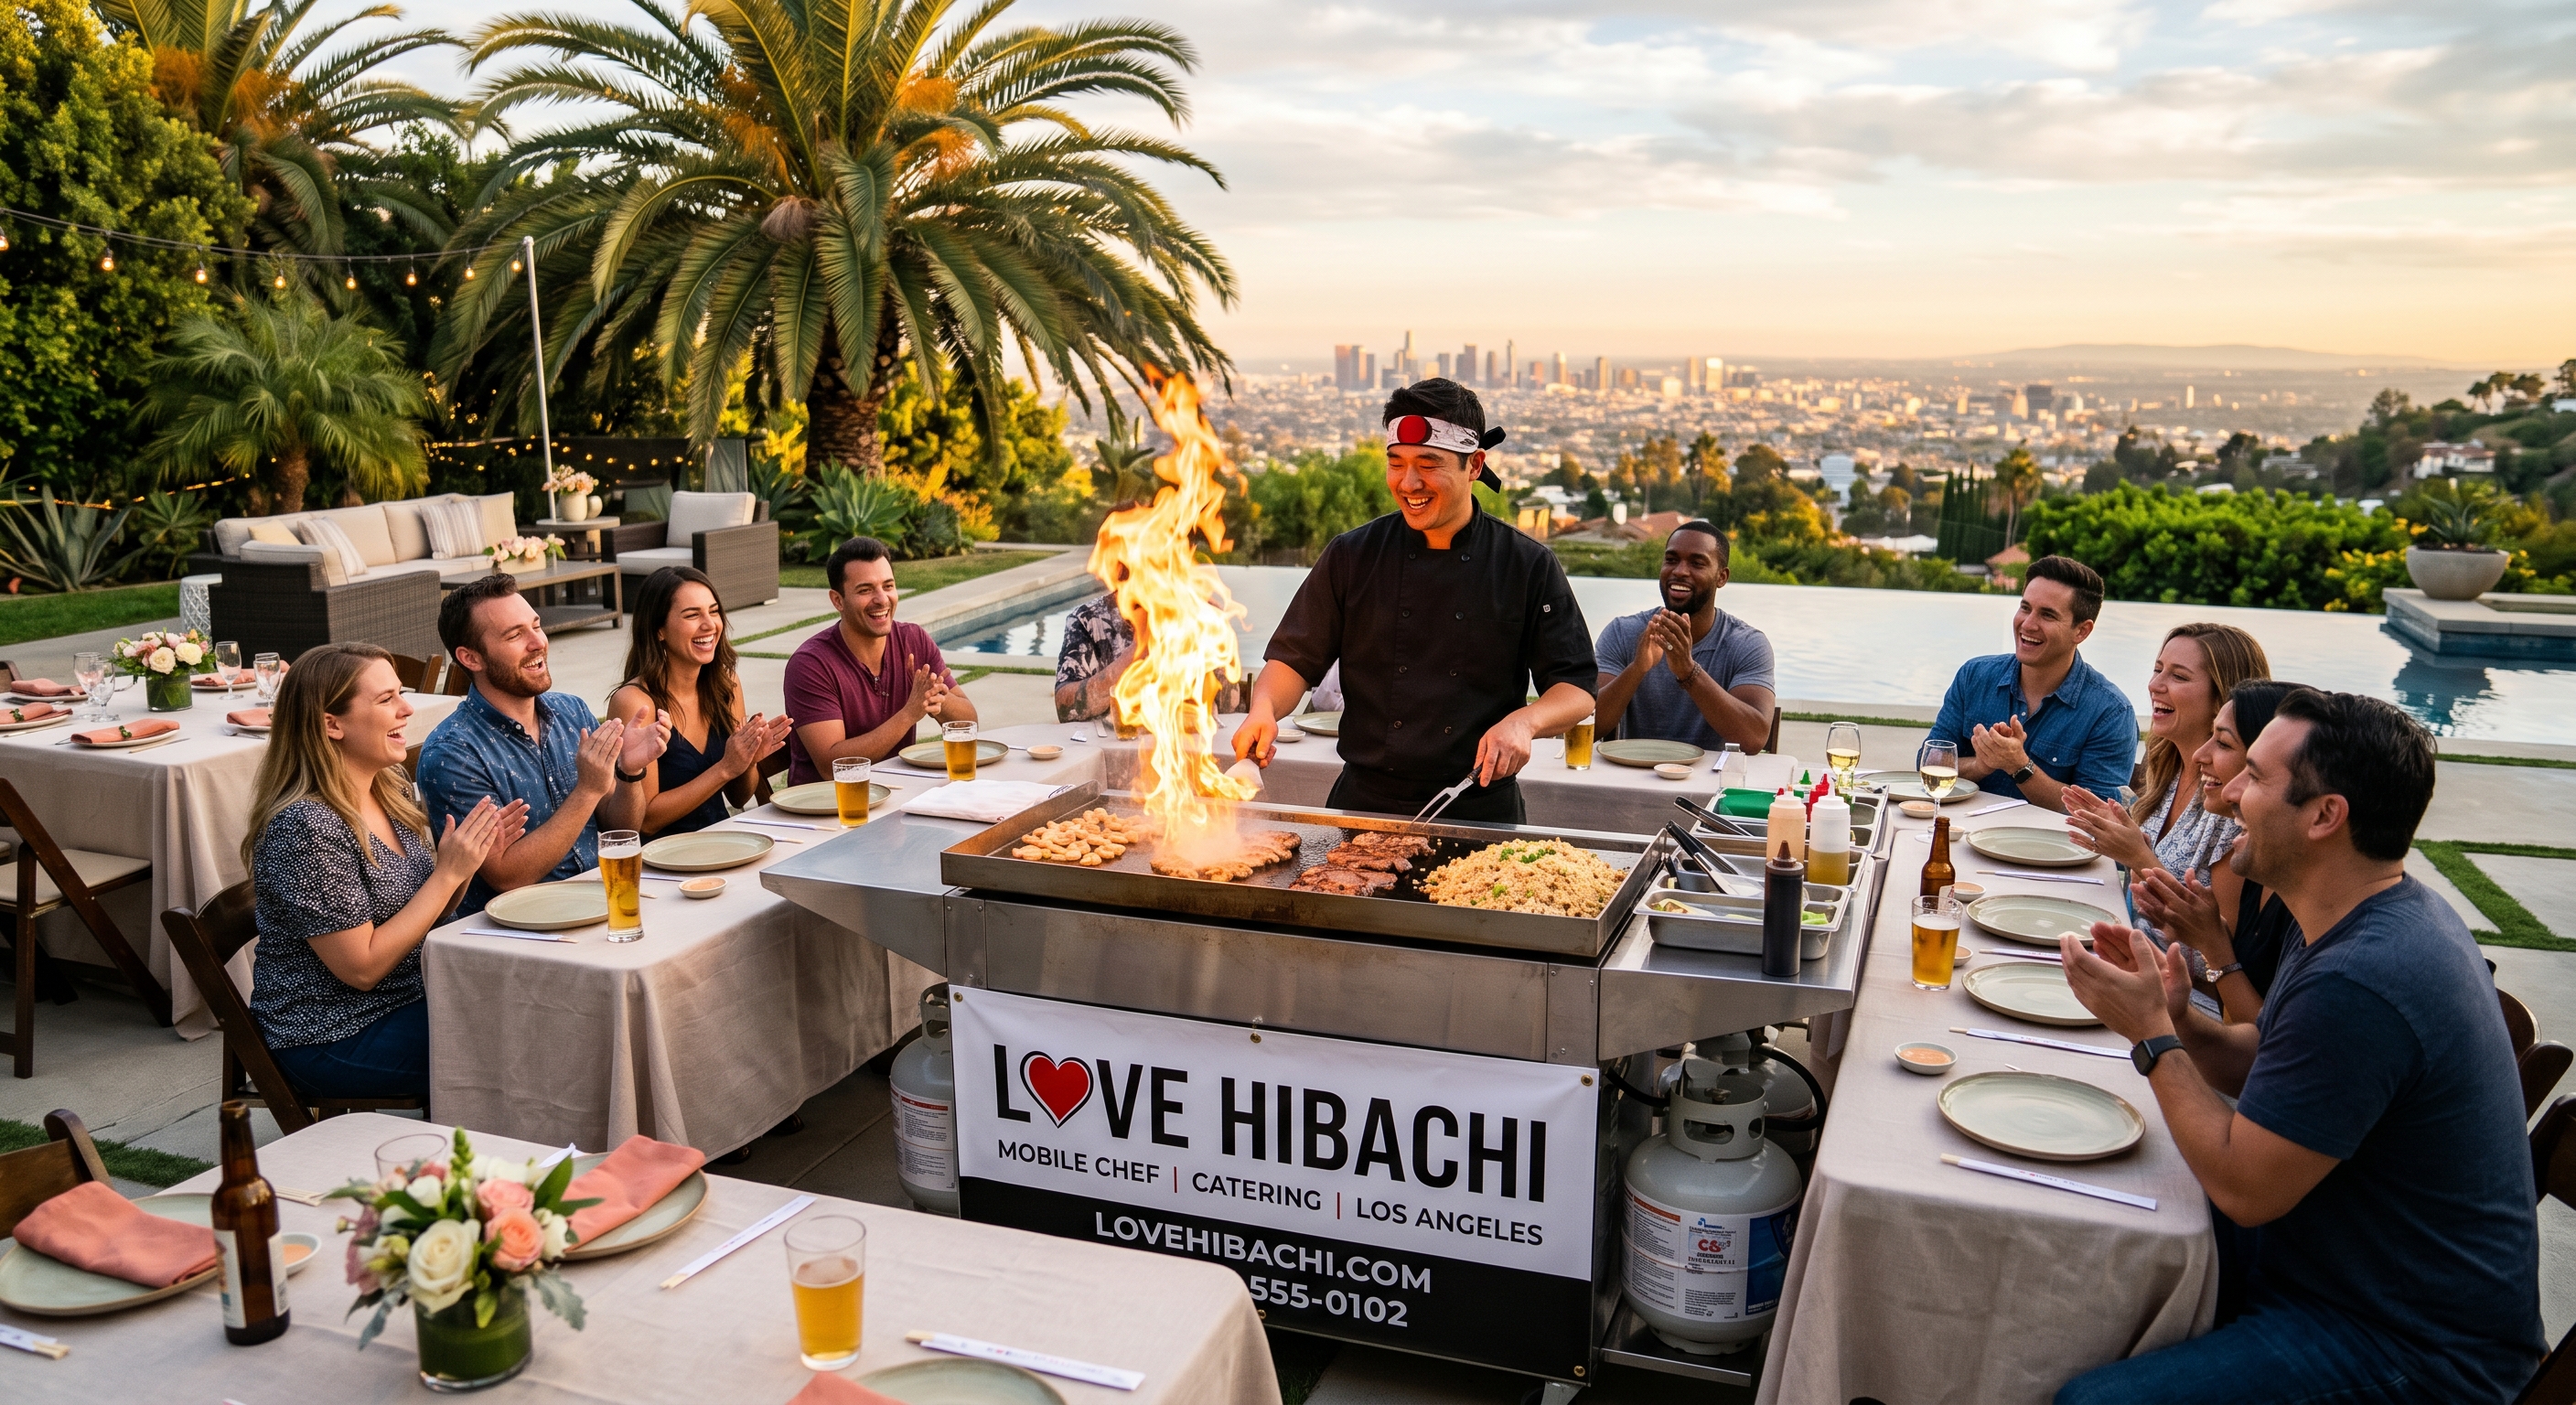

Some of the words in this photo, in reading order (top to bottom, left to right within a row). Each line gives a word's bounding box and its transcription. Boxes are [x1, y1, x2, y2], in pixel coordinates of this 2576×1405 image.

[998, 1139, 1089, 1174] MOBILE
[1095, 1156, 1160, 1185] CHEF
[1221, 1076, 1547, 1204] HIBACHI
[1192, 1172, 1321, 1211] CATERING
[1357, 1197, 1408, 1225] LOS
[1414, 1207, 1543, 1246] ANGELES
[1095, 1211, 1431, 1293] LOVEHIBACHI.COM
[1250, 1275, 1408, 1327] 555-0102
